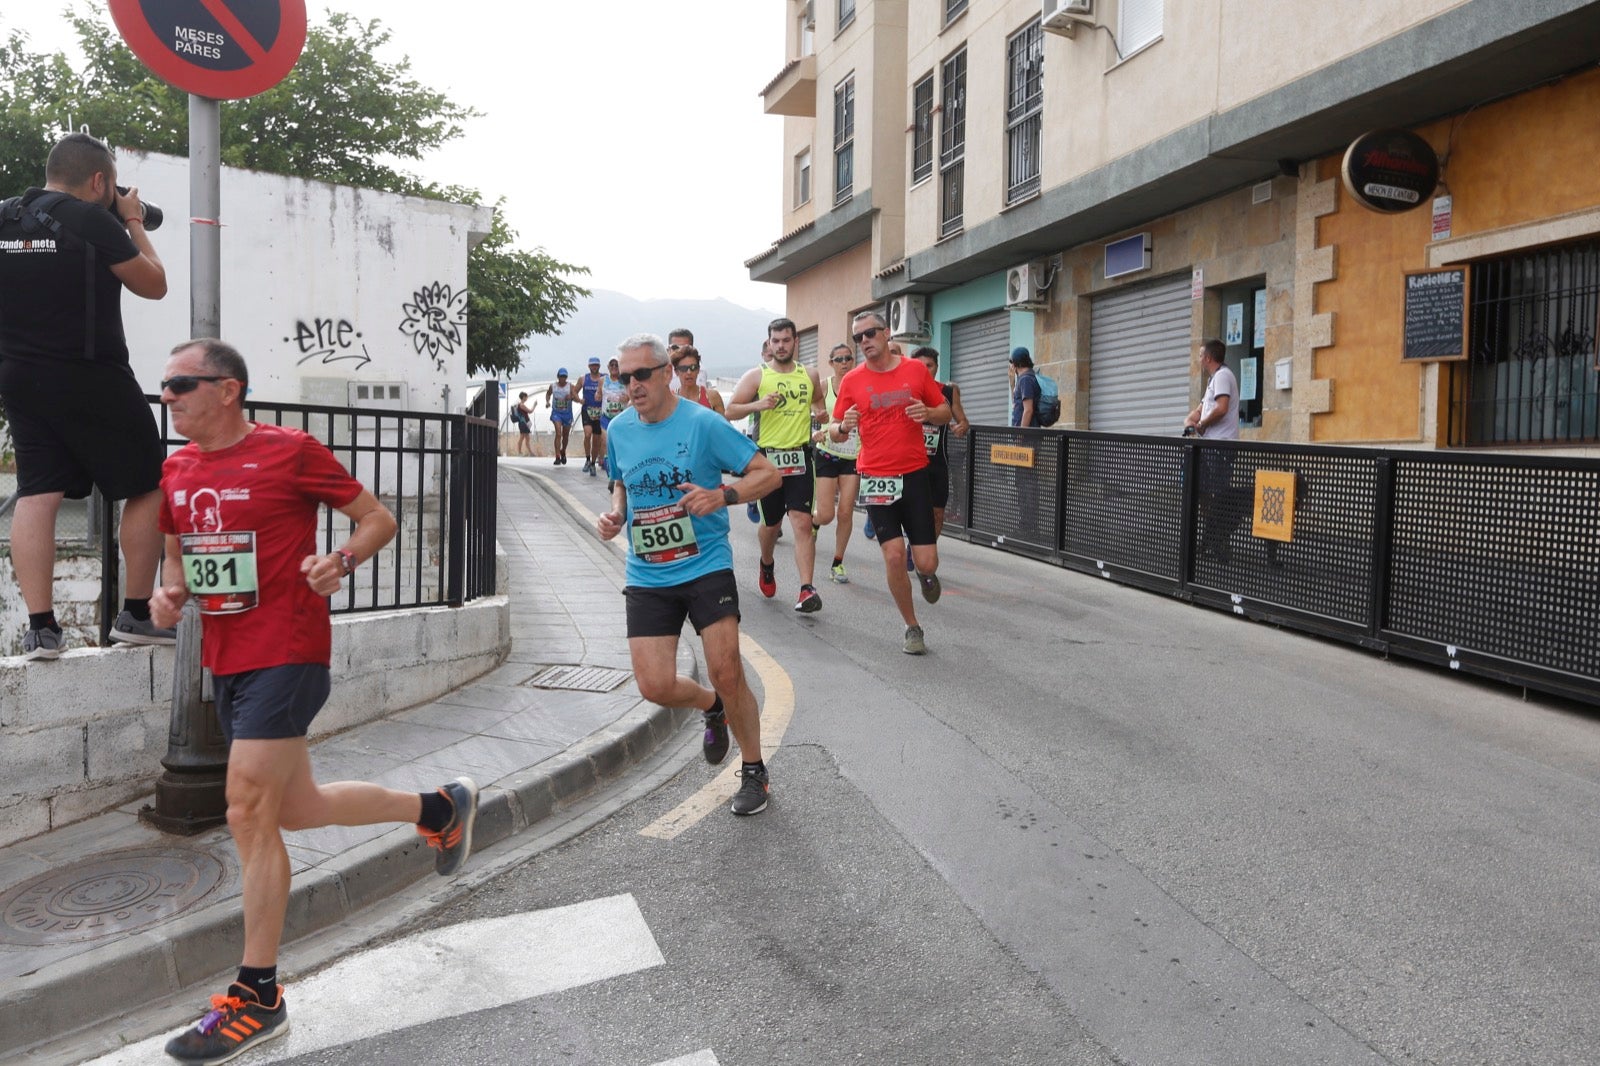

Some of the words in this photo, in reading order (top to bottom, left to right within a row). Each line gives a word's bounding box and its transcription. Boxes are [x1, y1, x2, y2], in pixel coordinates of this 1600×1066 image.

[175, 25, 225, 46] MESES
[175, 40, 221, 59] PARES
[1409, 271, 1461, 289] RACIONES
[774, 452, 799, 466] 108
[867, 480, 897, 493] 293
[641, 522, 684, 549] 580
[191, 557, 238, 588] 381
